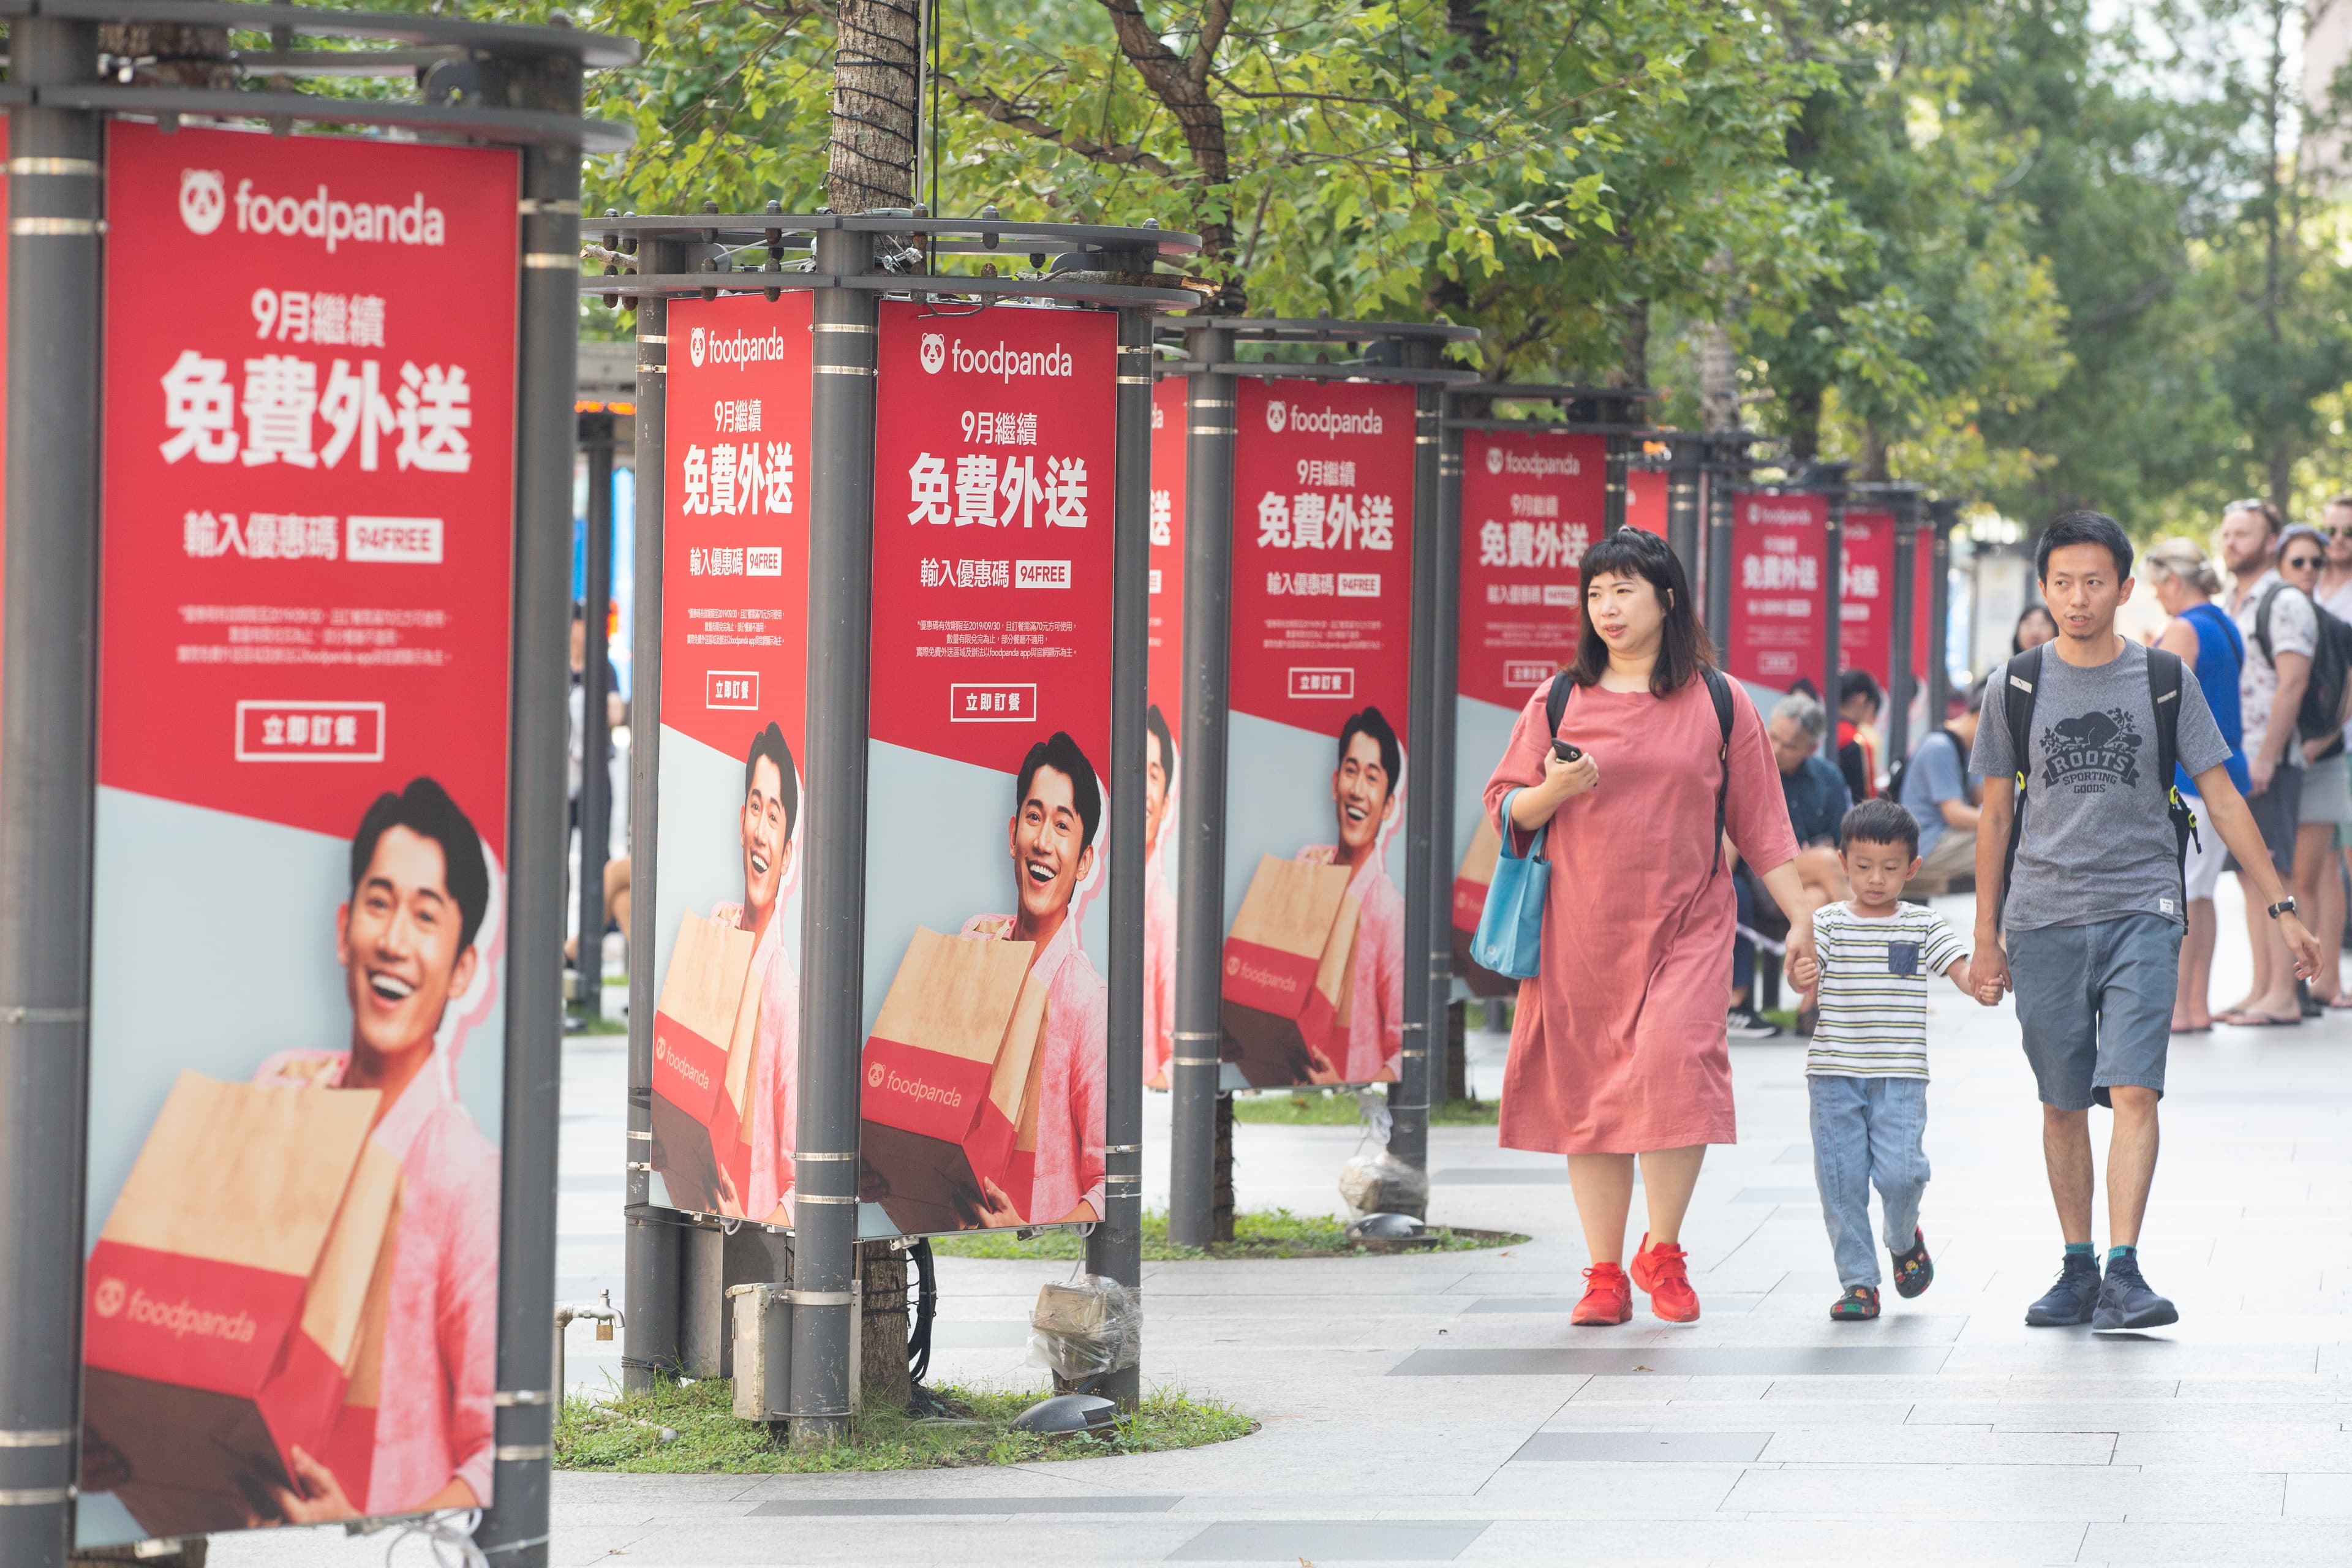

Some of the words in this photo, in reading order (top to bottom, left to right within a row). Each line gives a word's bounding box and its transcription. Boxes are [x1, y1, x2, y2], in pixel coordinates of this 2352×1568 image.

[235, 178, 445, 254] foodpanda
[251, 288, 385, 347] 9月繼續
[709, 326, 784, 372] foodpanda
[951, 338, 1072, 384] foodpanda
[159, 350, 472, 473] 免費外送
[714, 398, 762, 433] 9月繼續
[961, 410, 1038, 447] 9月繼續
[1290, 404, 1382, 440] foodpanda
[682, 440, 793, 516] 免費外送
[1297, 459, 1355, 488] 9月繼續
[1506, 450, 1580, 480] foodpanda
[907, 451, 1088, 529] 免費外送
[183, 511, 339, 560] 輸入優惠碼
[356, 527, 432, 552] 94FREE
[1257, 491, 1393, 551] 免費外送
[690, 546, 744, 577] 輸入優惠碼
[749, 553, 778, 570] 94FREE
[1479, 519, 1589, 568] 免費外送
[920, 557, 1009, 589] 輸入優惠碼
[1020, 565, 1065, 583] 94FREE
[1342, 578, 1376, 592] 94FREE
[715, 680, 749, 700] 立即訂餐
[965, 692, 1020, 712] 立即訂餐
[262, 715, 356, 745] 立即訂餐
[2052, 750, 2129, 774] ROOTS
[2062, 771, 2118, 786] SPORTING
[2073, 783, 2106, 794] GOODS
[1240, 962, 1297, 992] foodpanda
[666, 1044, 709, 1090] foodpanda
[886, 1070, 962, 1108] foodpanda
[126, 1289, 257, 1344] foodpanda
